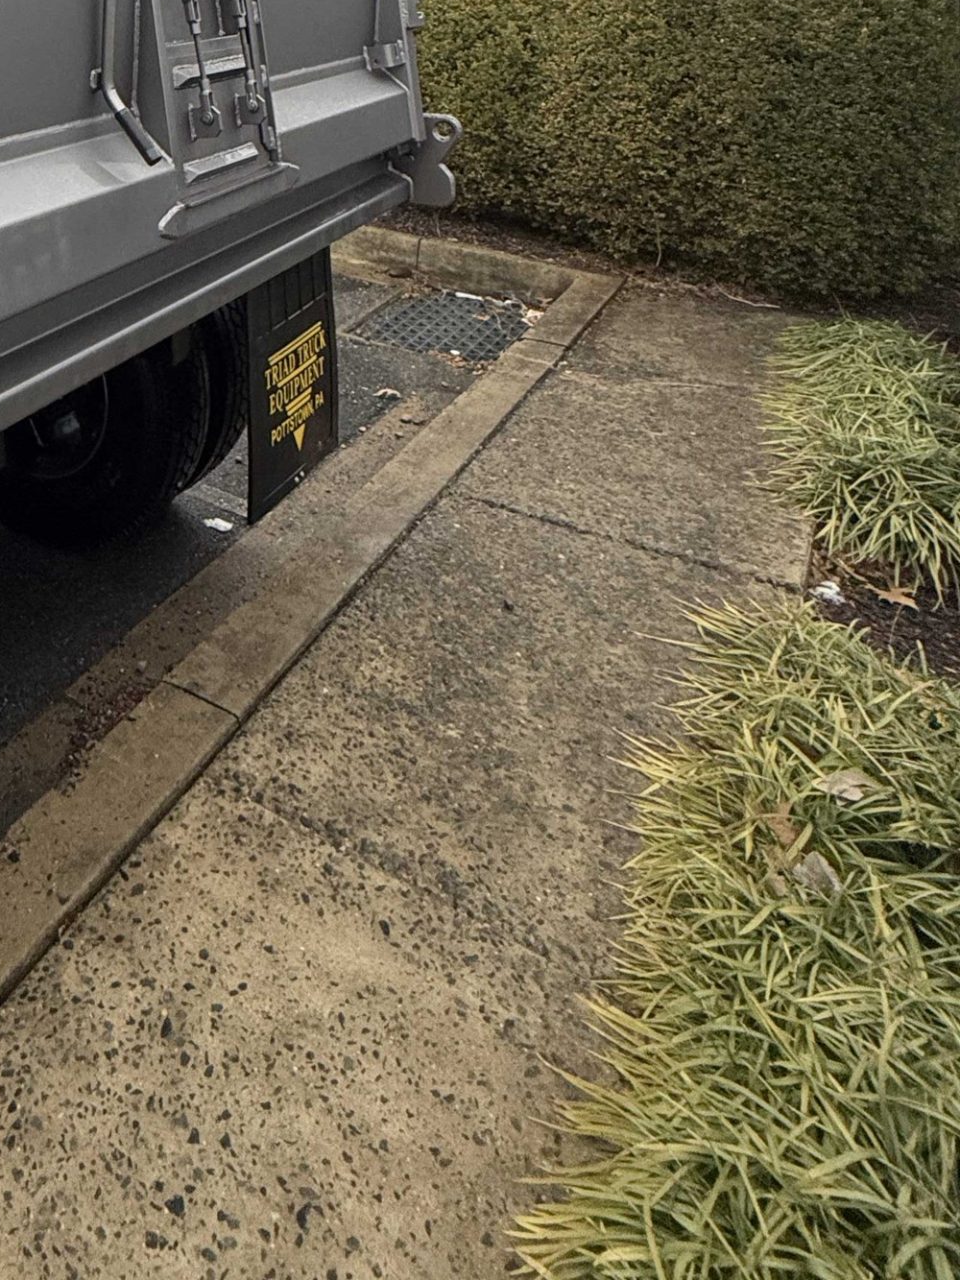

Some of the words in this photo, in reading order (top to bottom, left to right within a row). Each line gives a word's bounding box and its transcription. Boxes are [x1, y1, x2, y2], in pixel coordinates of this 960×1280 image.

[264, 353, 296, 390] TRIAD
[296, 329, 326, 364] TRUCK
[269, 356, 325, 416] EQUIPMENT
[315, 391, 325, 410] PA
